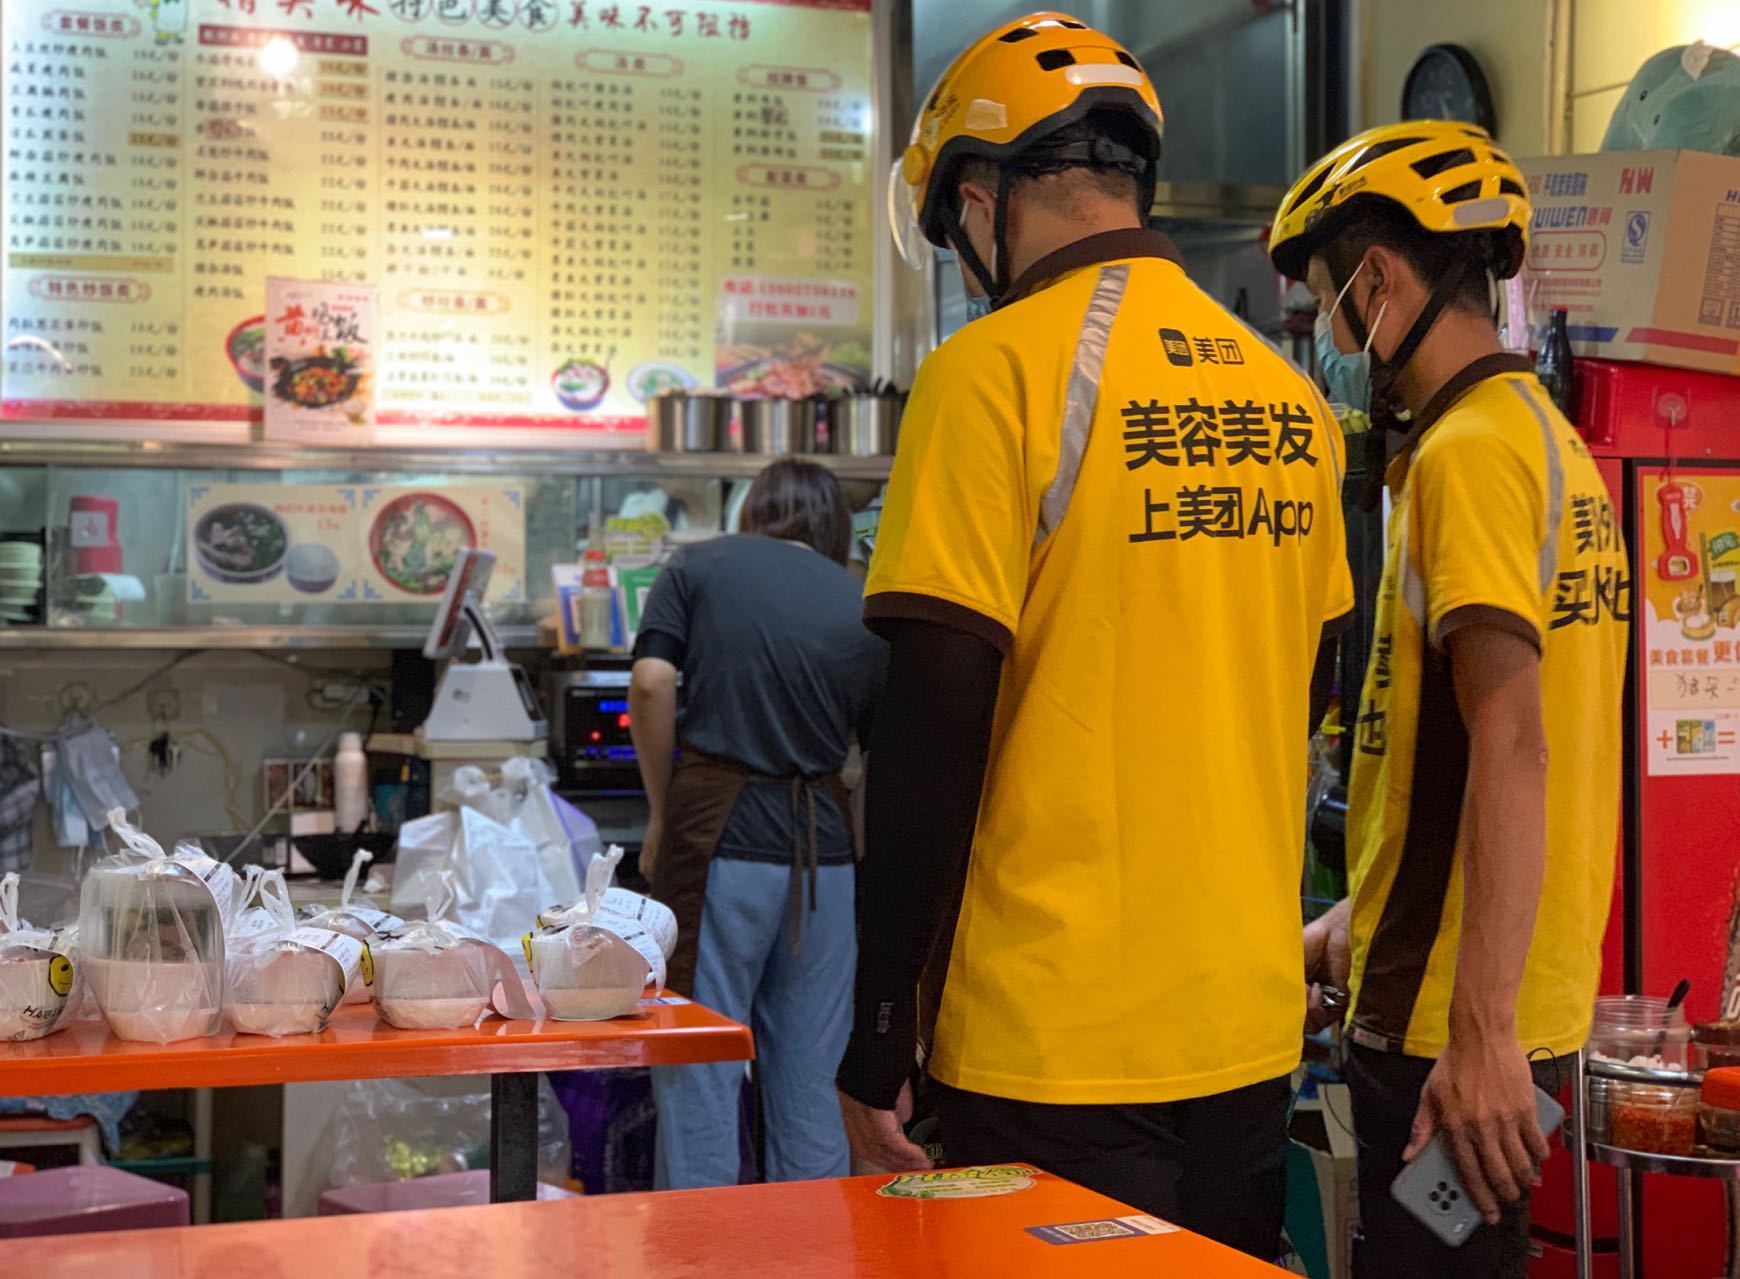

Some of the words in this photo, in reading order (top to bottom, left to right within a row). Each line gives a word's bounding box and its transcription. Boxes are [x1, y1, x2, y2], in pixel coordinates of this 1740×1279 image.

[1533, 206, 1587, 229] UIWEN
[1192, 336, 1245, 365] 美团
[1120, 398, 1319, 471] 美容美发
[1128, 484, 1314, 548] 上美团App
[1650, 648, 1709, 666] 美食套餐
[1713, 640, 1740, 664] 更
